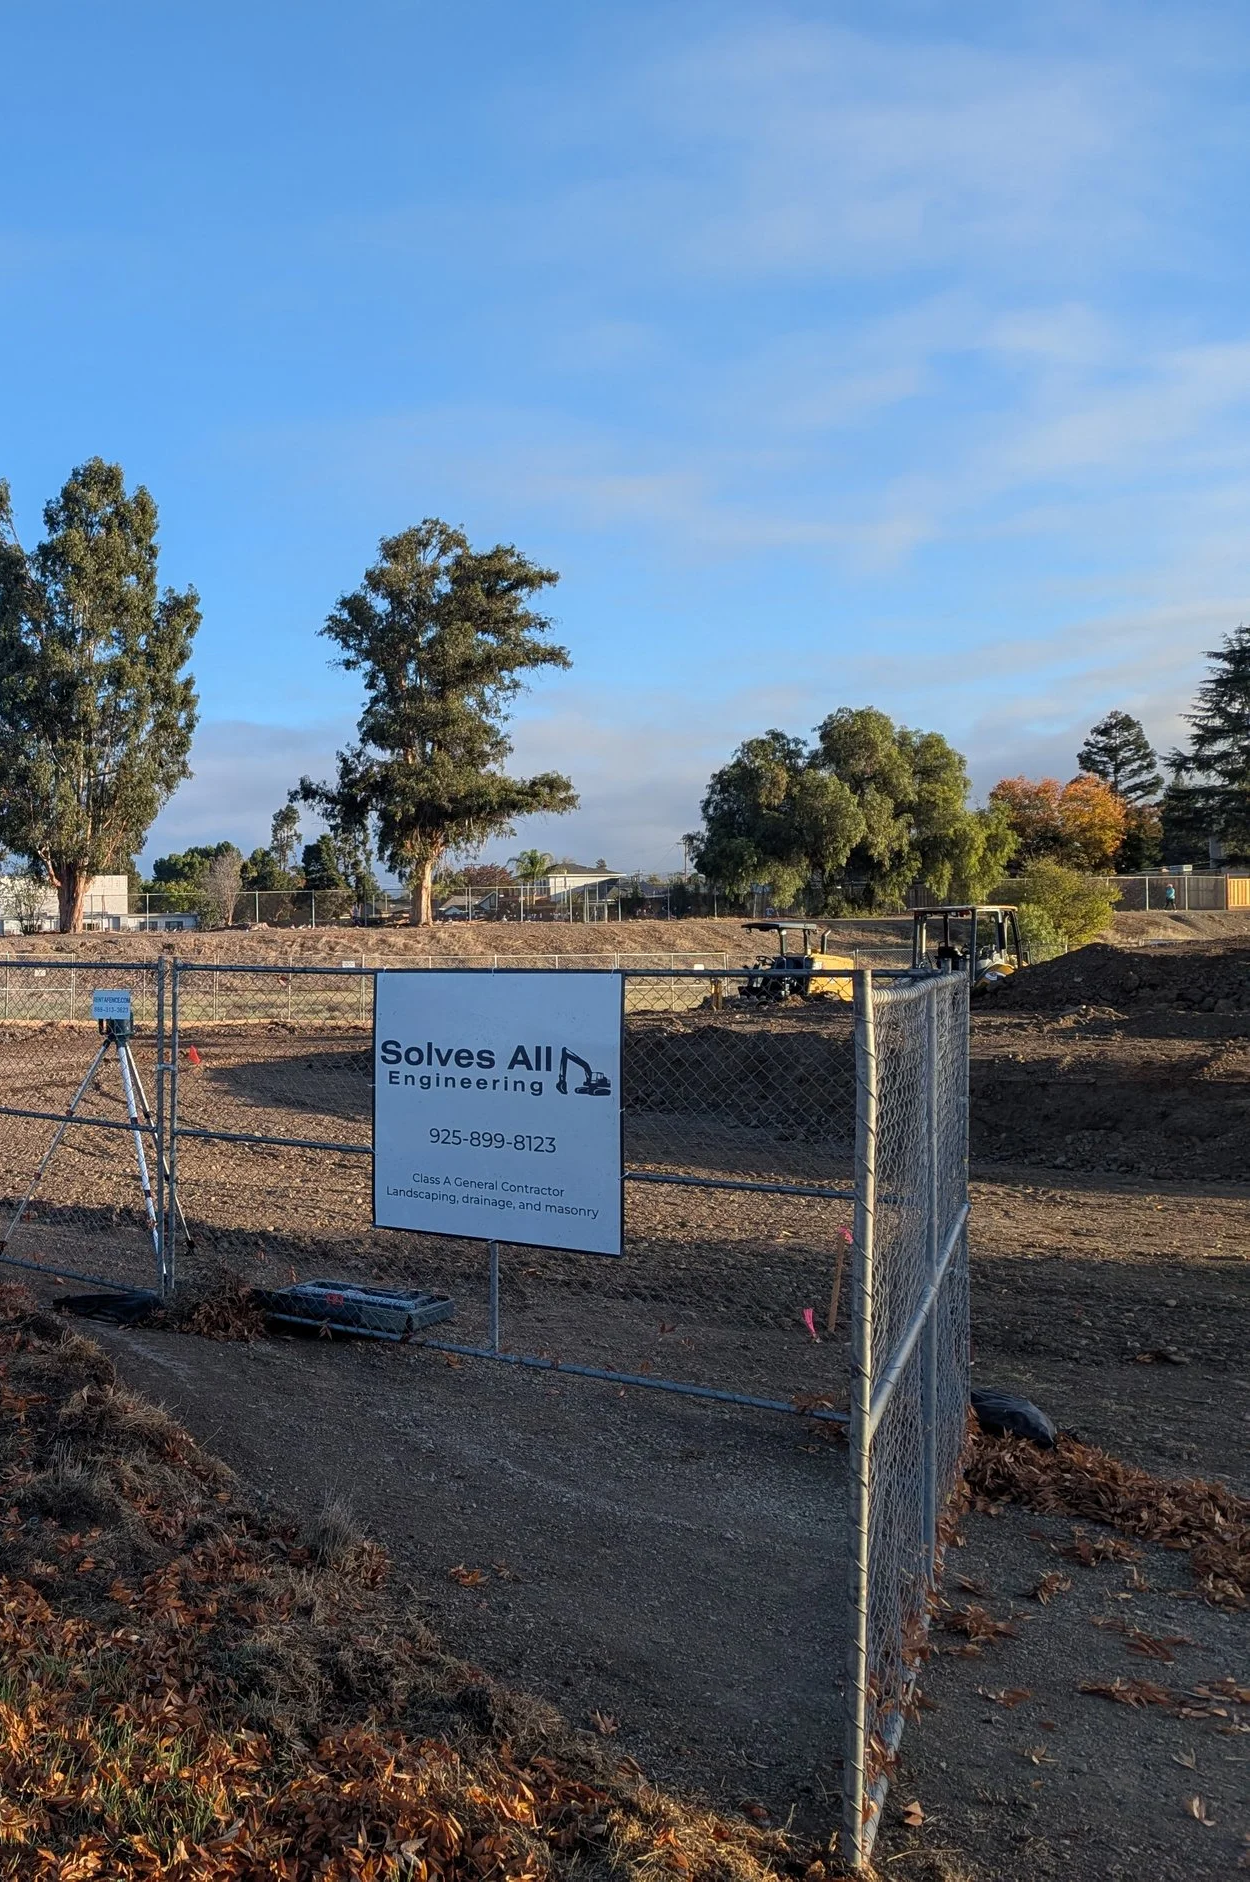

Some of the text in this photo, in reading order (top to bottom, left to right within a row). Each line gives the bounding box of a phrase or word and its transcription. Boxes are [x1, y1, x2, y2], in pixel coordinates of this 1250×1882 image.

[380, 1039, 552, 1072] Solves All
[388, 1070, 544, 1097] Engineering
[429, 1127, 557, 1154] 925-899-8123
[412, 1173, 565, 1198] Class A General Contractor
[386, 1186, 599, 1220] Landscaping, drainage, and masonry
